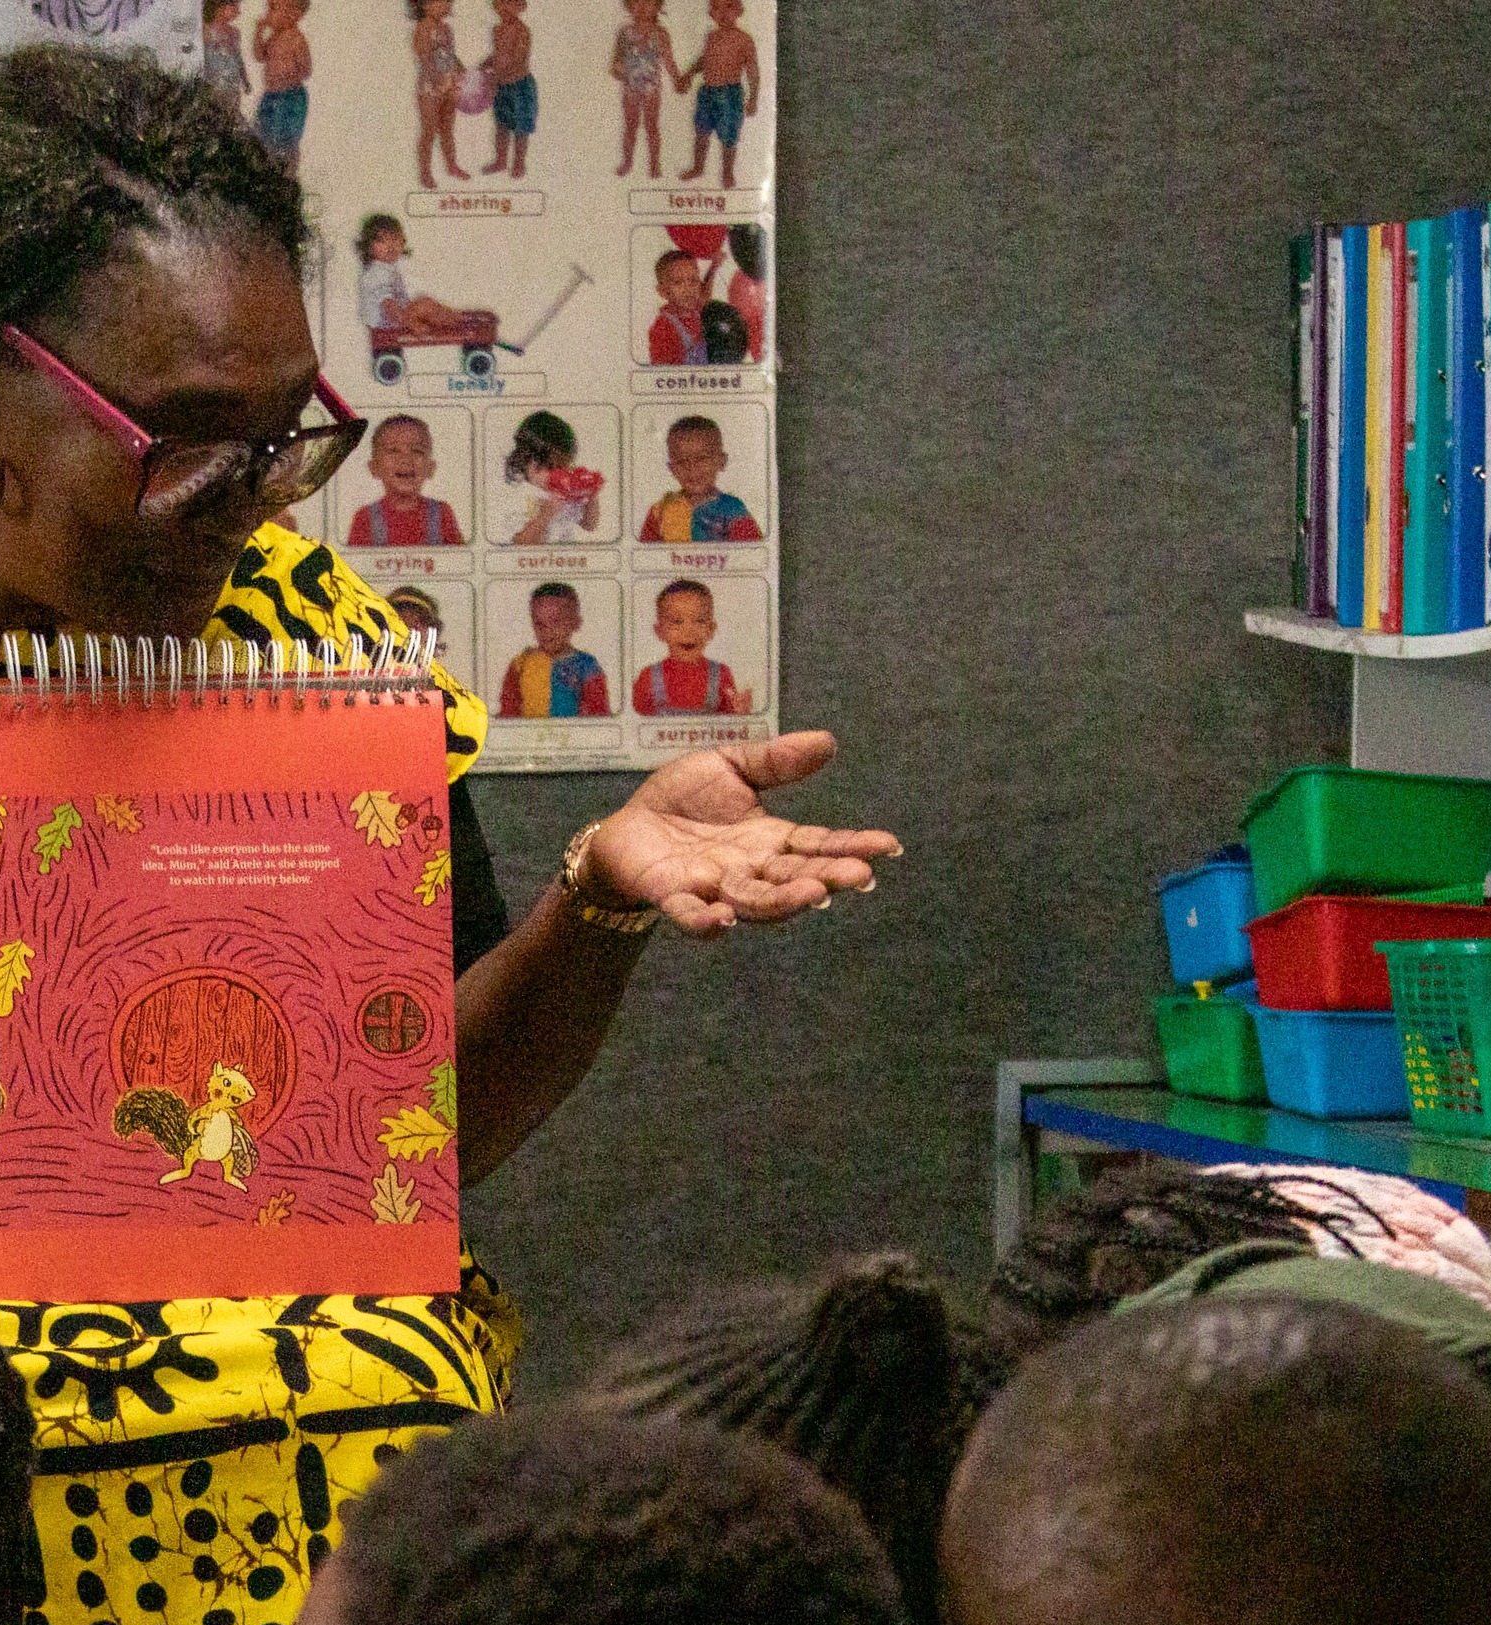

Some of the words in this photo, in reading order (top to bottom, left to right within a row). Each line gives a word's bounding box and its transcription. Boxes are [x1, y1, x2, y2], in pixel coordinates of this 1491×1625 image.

[438, 197, 512, 214] sharing
[668, 194, 726, 211] loving
[448, 375, 506, 396] lonely
[655, 373, 742, 389] confused
[375, 557, 434, 573] crying
[518, 555, 588, 568] curious
[670, 552, 729, 569] happy
[657, 727, 749, 743] surprised
[190, 844, 210, 854] like
[213, 845, 259, 855] everyone
[262, 844, 281, 853] has
[283, 844, 300, 853] the
[303, 845, 330, 853] same
[207, 861, 230, 869] said
[278, 860, 296, 869] she
[299, 859, 339, 871] stopped
[170, 876, 180, 885] to
[183, 876, 215, 885] watch
[217, 876, 234, 885] the
[237, 875, 275, 886] activity
[280, 874, 313, 884] below.
